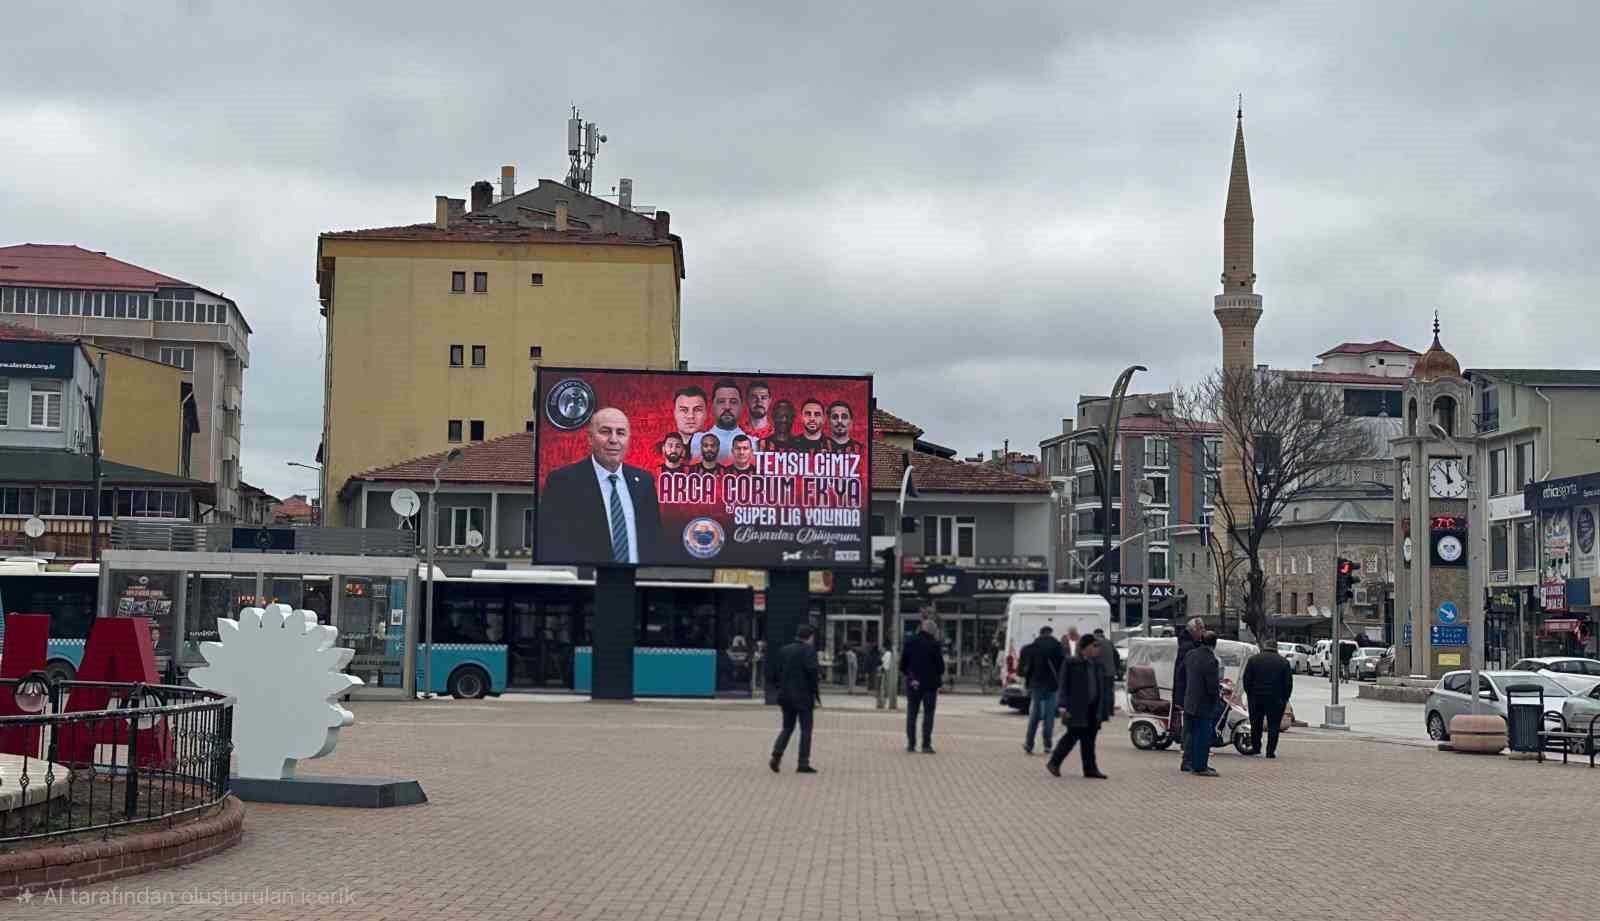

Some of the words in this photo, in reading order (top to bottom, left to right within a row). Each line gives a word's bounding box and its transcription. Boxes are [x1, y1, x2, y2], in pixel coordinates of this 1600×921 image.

[657, 471, 717, 505] ARCA
[722, 473, 796, 513] ÇORUM
[734, 506, 777, 525] SÜPER
[804, 508, 861, 527] YOLUNDA
